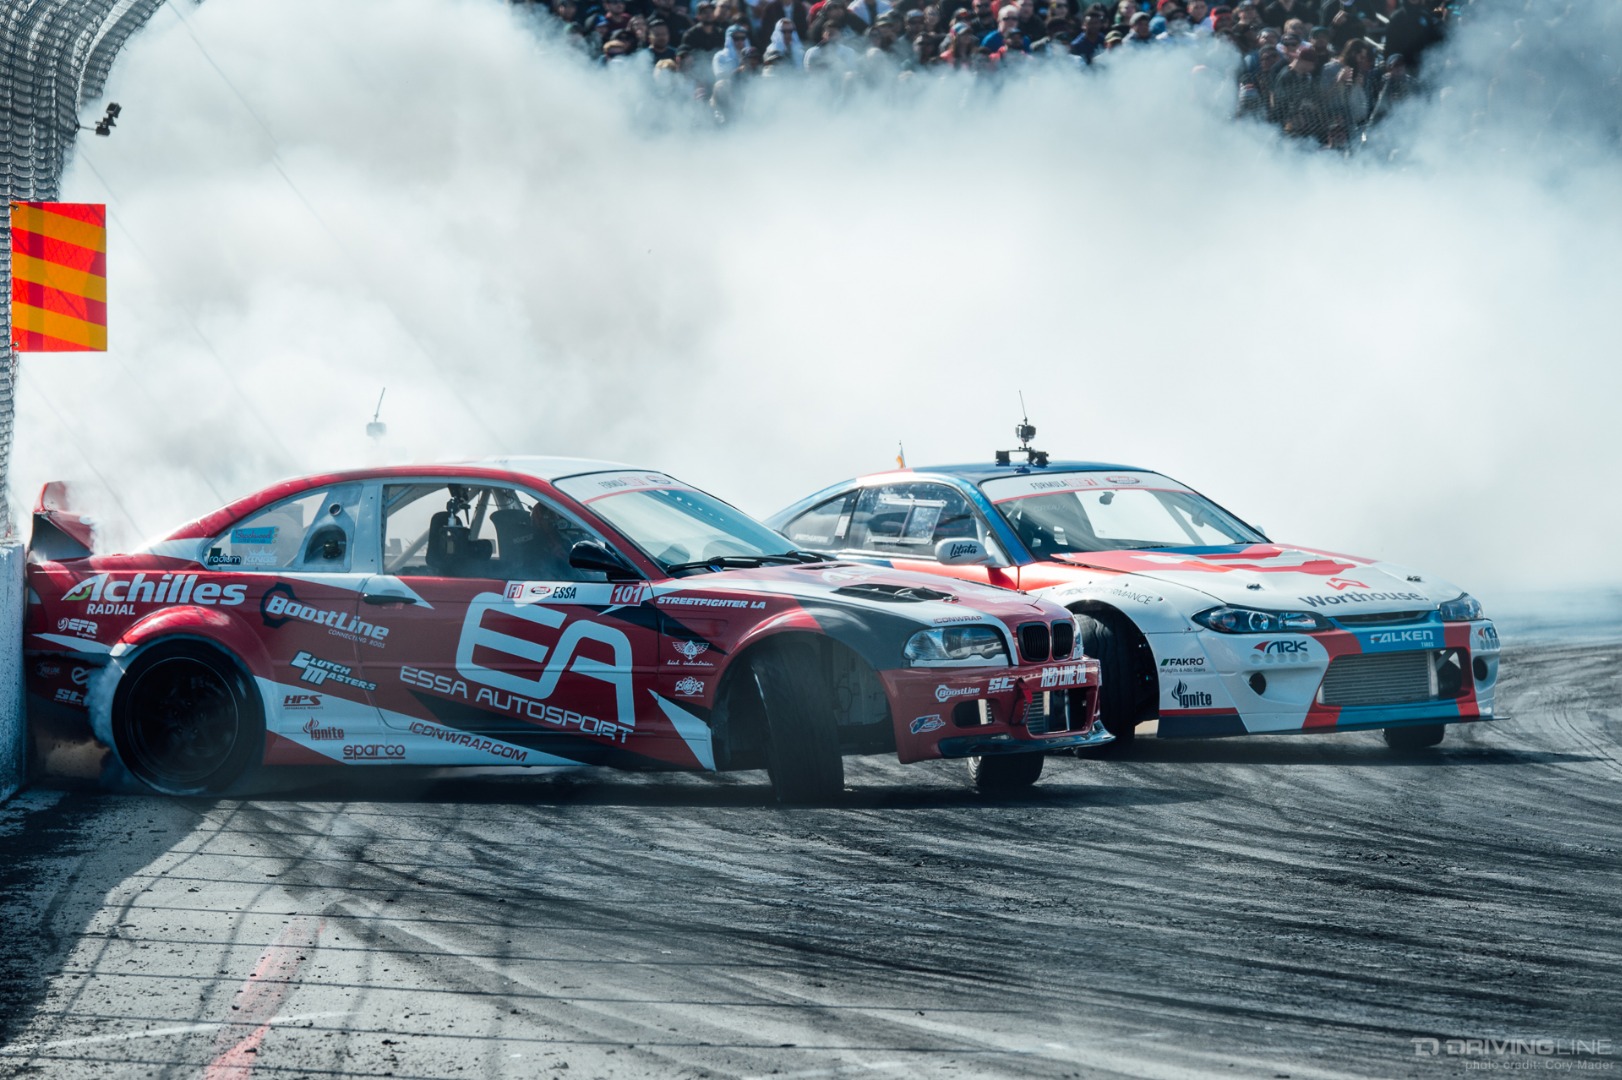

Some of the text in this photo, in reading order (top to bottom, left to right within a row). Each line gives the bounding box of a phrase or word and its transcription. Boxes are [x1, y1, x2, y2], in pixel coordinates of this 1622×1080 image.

[1030, 480, 1068, 490] FORMULA
[209, 553, 241, 564] radium
[61, 573, 248, 606] Achilles
[552, 586, 577, 599] ESSA
[613, 585, 642, 604] 101
[86, 603, 135, 615] RADIAL
[657, 596, 766, 609] STREETFIGHTER LA
[266, 595, 389, 640] BoostLine
[933, 615, 982, 624] ICONWRAP
[68, 618, 98, 634] EFR
[328, 629, 386, 649] CONNECTING RODS
[1370, 630, 1433, 644] FALKEN
[1266, 640, 1308, 654] ARK
[291, 651, 351, 675] CLUTCH
[456, 592, 635, 726] EA
[1170, 657, 1204, 666] FAKRO
[301, 665, 377, 691] MASTERS
[1041, 663, 1087, 688] RED LINE OIL
[284, 695, 323, 706] HPS
[400, 665, 634, 744] ESSA AUTOSPORT
[1179, 692, 1213, 708] ignite
[310, 726, 345, 741] ignite
[409, 721, 528, 763] ICONWRAP.COM
[343, 744, 406, 760] sparco
